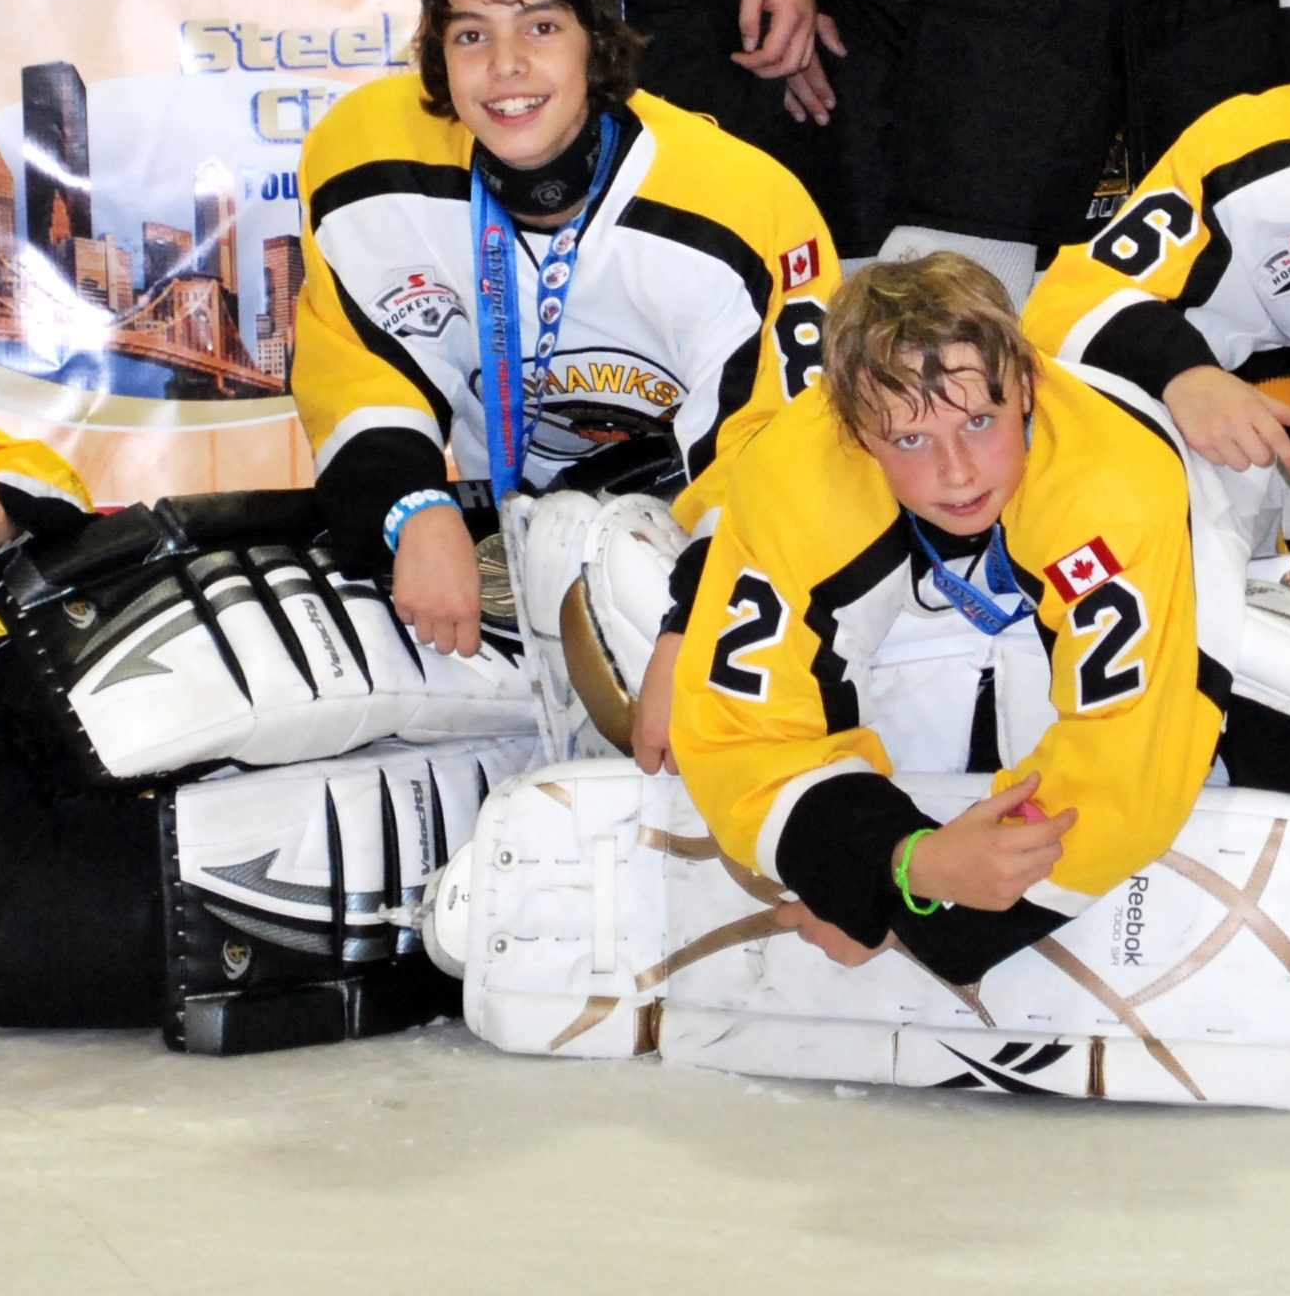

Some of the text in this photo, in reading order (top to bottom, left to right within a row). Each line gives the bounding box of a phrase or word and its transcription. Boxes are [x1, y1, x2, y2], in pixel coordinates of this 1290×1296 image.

[180, 11, 410, 75] Steel
[382, 294, 432, 331] HOCKEY
[707, 567, 790, 703] 2
[1069, 576, 1149, 713] 2
[1124, 875, 1150, 967] Reebok
